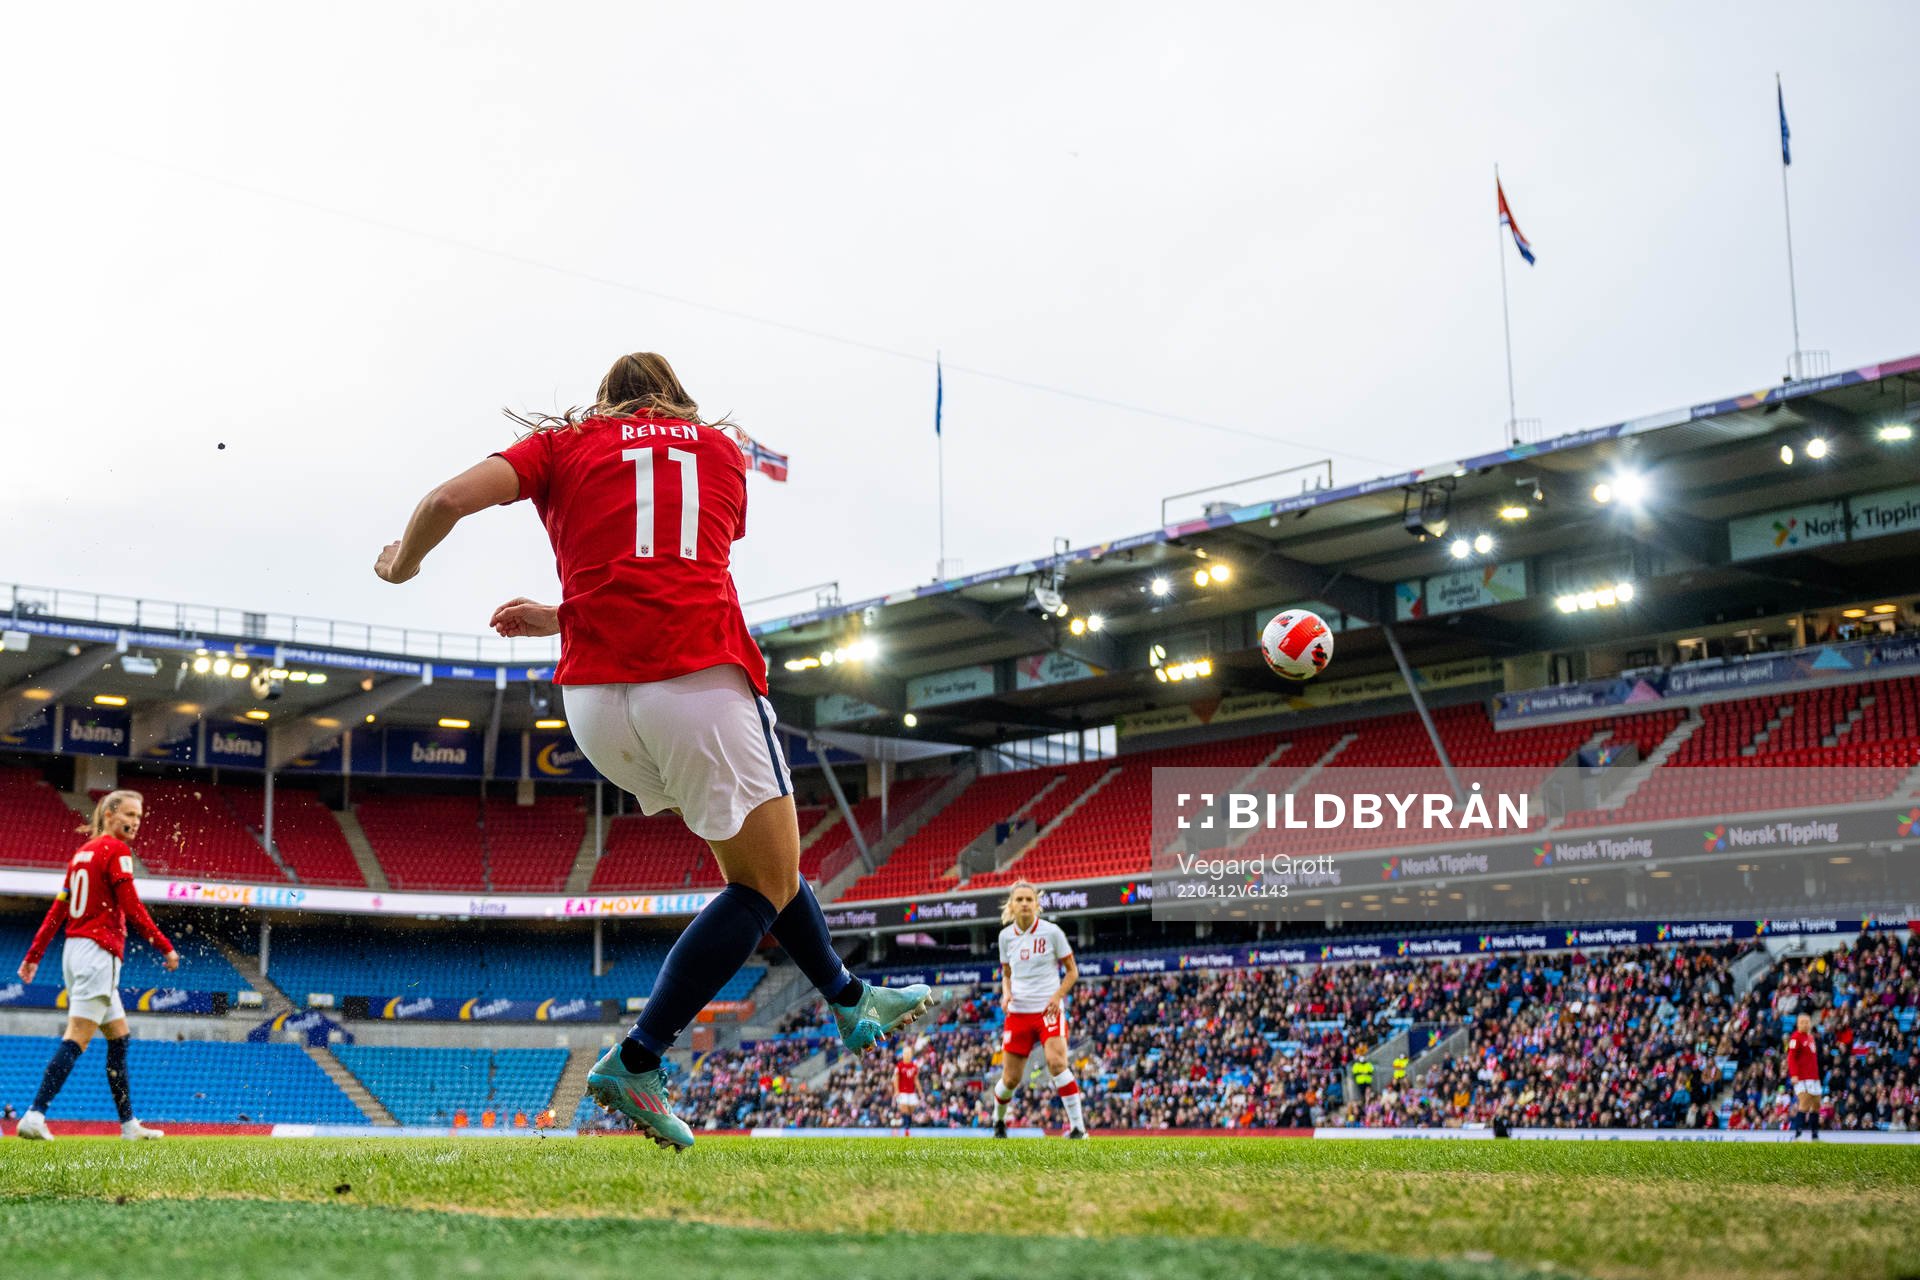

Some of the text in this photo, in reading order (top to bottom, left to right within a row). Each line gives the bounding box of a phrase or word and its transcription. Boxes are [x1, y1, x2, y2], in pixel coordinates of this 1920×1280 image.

[622, 424, 699, 441] REITEN
[622, 447, 699, 561] 11
[70, 719, 124, 743] bama
[212, 732, 262, 756] bama
[412, 741, 467, 764] bama
[1729, 821, 1838, 846] Norsk Tipping
[1555, 837, 1652, 861] Norsk Tipping
[1401, 853, 1488, 876] Norsk Tipping
[167, 882, 306, 907] EAT MOVE SLEEP
[1051, 891, 1088, 909] Tipping
[565, 895, 707, 915] EAT MOVE SLEEP
[918, 901, 977, 919] Norsk Tipping
[1579, 928, 1636, 944] Norsk Tipping
[1671, 923, 1733, 938] Norsk Tipping
[1033, 938, 1046, 954] 18
[1409, 939, 1461, 954] Norsk Tipping
[1491, 934, 1546, 948] Norsk Tipping
